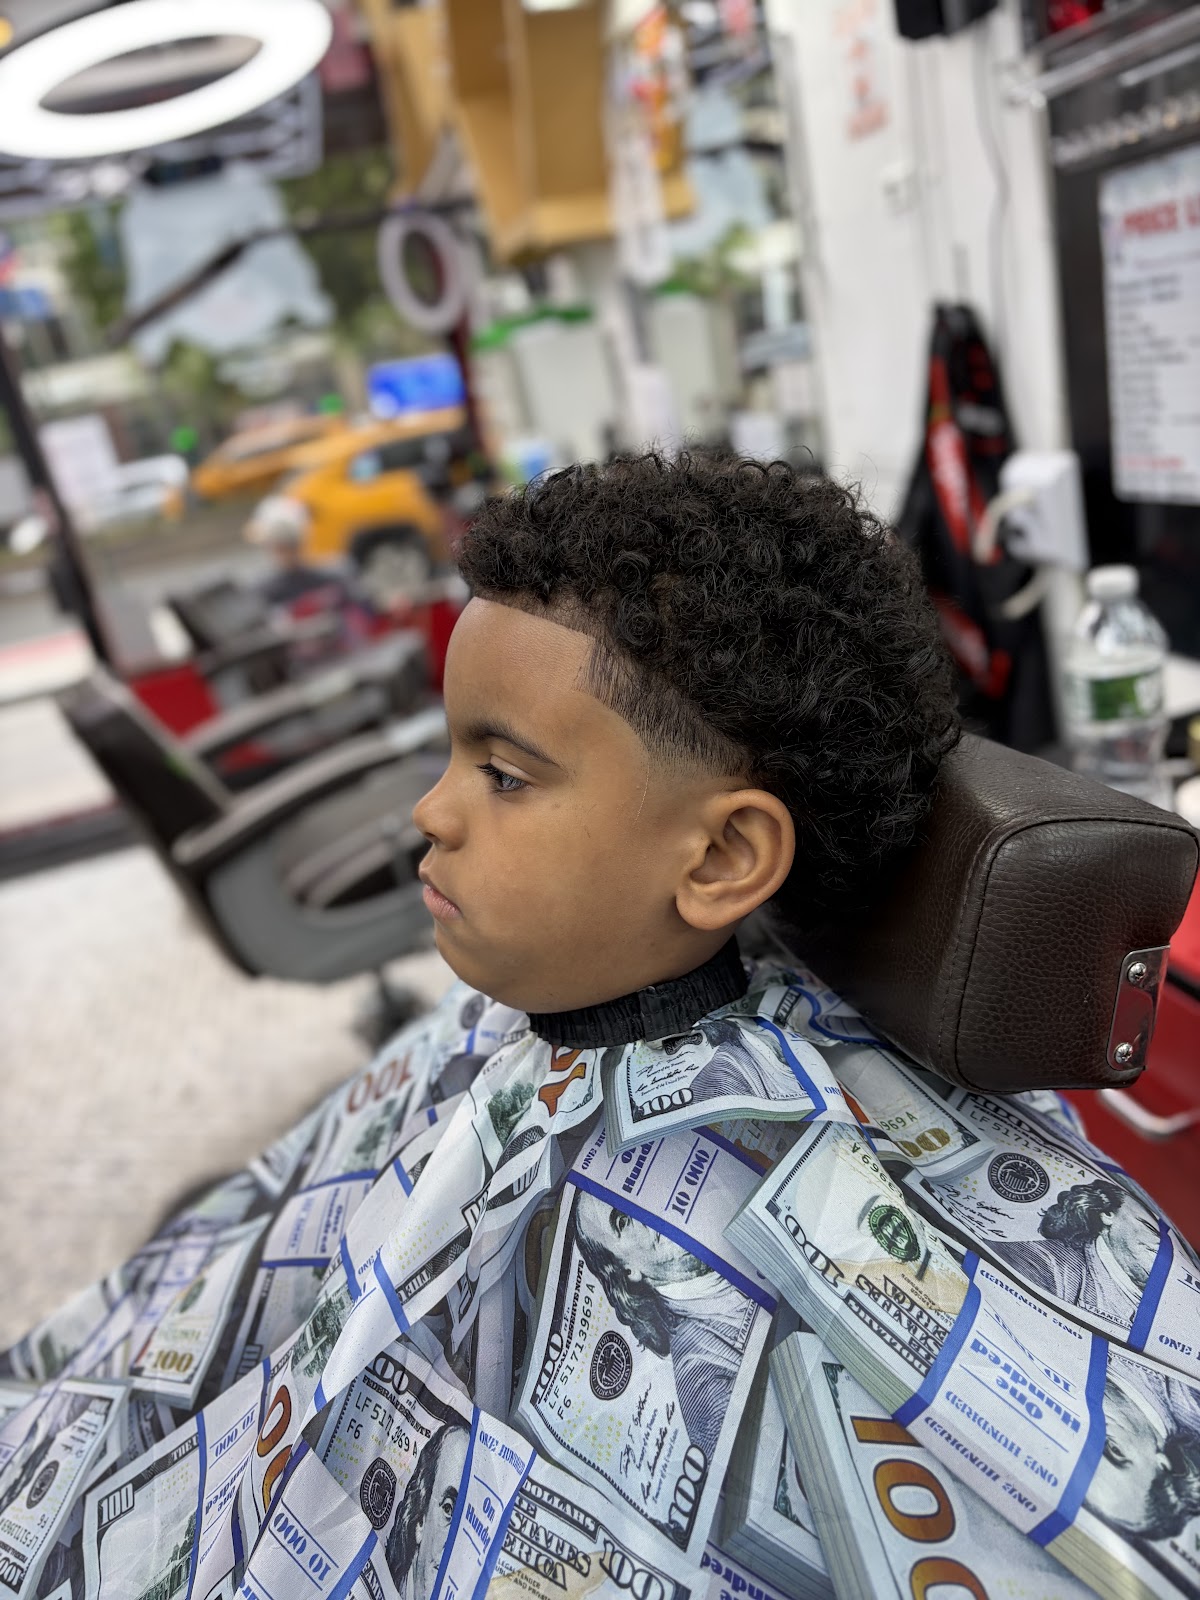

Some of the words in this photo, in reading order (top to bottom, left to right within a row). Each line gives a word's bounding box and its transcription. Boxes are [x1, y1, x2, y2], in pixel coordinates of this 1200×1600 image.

[640, 1088, 694, 1115] 100
[581, 1148, 598, 1171] ONE
[671, 1191, 691, 1217] 10
[684, 1149, 711, 1187] 000
[785, 1214, 845, 1287] 100
[856, 1273, 943, 1357] STATES
[979, 1268, 1048, 1318] HUNDRED
[548, 1386, 560, 1410] LF
[560, 1295, 593, 1387] 51713969
[585, 1283, 596, 1295] A
[1052, 1317, 1083, 1341] ONE
[1158, 1333, 1193, 1356] ONE
[151, 1349, 194, 1373] 100
[536, 1332, 564, 1404] 100
[970, 1337, 1081, 1433] Hundred
[996, 1375, 1043, 1420] One
[346, 1417, 364, 1440] F6
[557, 1396, 572, 1421] F6
[945, 1390, 1021, 1458] HUNDRED
[171, 1438, 193, 1461] THE
[924, 1415, 1001, 1482] HUNDRED
[668, 1444, 708, 1535] 100
[1024, 1457, 1059, 1488] ONE
[100, 1482, 134, 1526] 100
[1002, 1482, 1037, 1513] ONE
[273, 1512, 307, 1555] 000
[508, 1509, 592, 1578] STATES
[308, 1552, 332, 1582] 10
